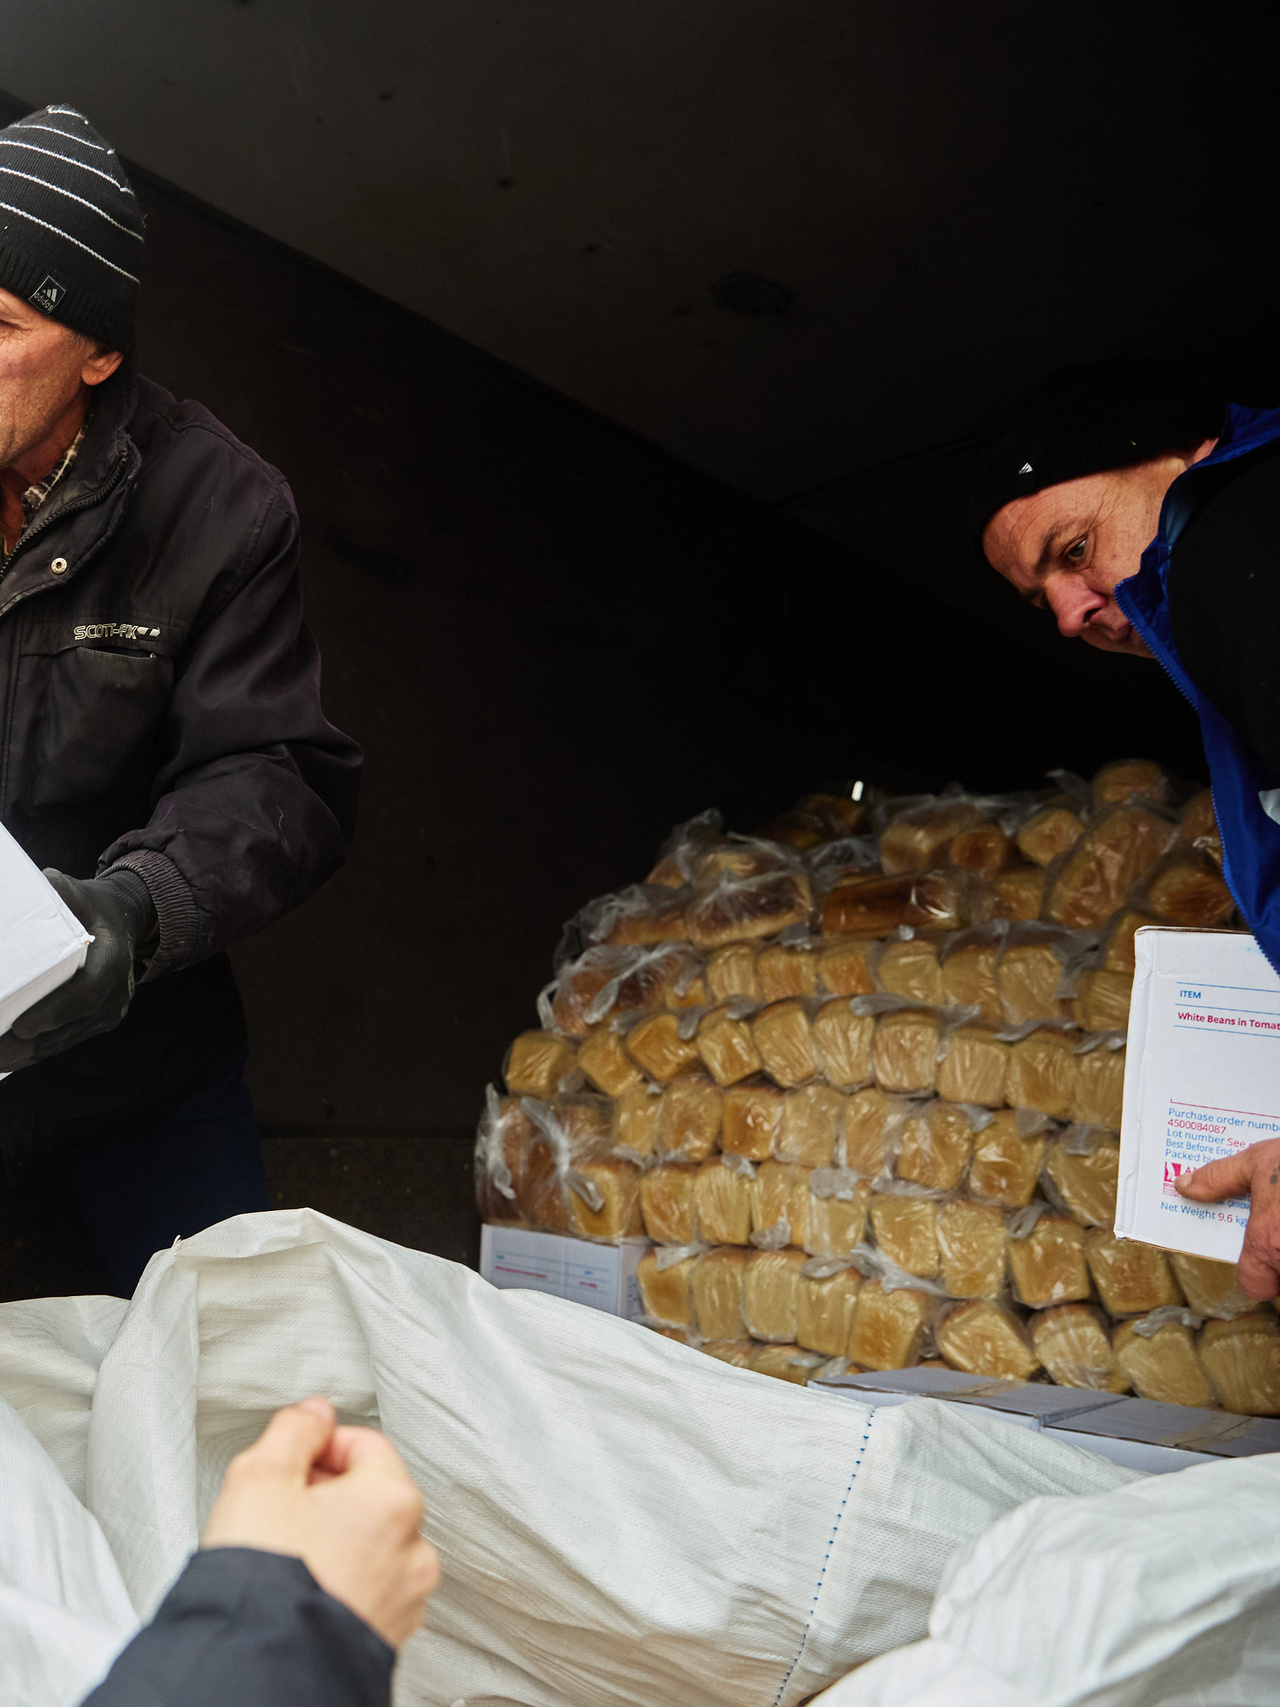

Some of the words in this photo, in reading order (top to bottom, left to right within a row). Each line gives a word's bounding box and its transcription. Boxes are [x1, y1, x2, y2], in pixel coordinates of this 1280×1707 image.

[33, 292, 54, 311] adidas
[1180, 990, 1202, 999] ITEM
[1177, 1011, 1205, 1022] White
[1207, 1015, 1236, 1026] Beans
[1237, 1017, 1247, 1027] in
[1167, 1118, 1227, 1134] 4500084087
[1168, 1107, 1214, 1122] Purchase
[1216, 1115, 1245, 1127] order
[1247, 1120, 1280, 1132] numb
[1165, 1138, 1184, 1148] Best
[1185, 1141, 1214, 1154] Before
[1166, 1128, 1183, 1138] Lot
[1184, 1131, 1225, 1145] number
[1226, 1137, 1246, 1149] See
[1165, 1148, 1200, 1162] Packed
[1160, 1201, 1178, 1213] Net
[1180, 1205, 1216, 1220] Weight
[1217, 1212, 1234, 1223] 9.6
[1235, 1214, 1248, 1228] kg
